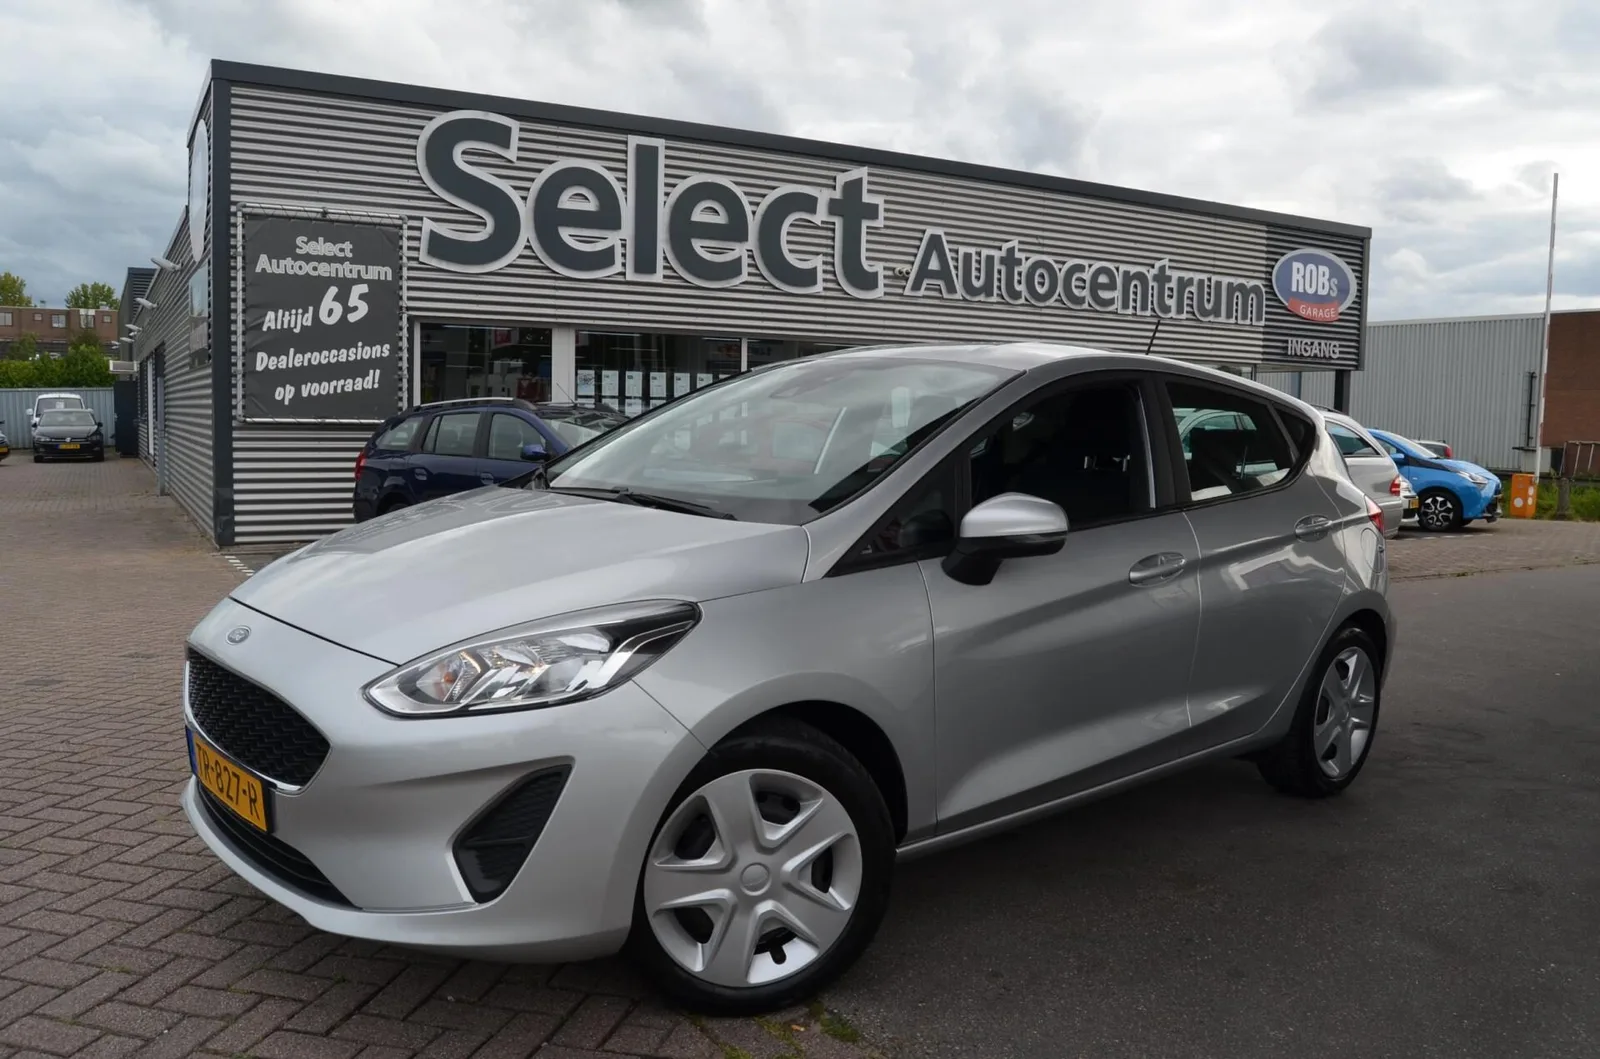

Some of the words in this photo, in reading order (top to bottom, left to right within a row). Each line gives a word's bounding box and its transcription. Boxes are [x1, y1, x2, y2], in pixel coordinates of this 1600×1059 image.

[417, 110, 884, 299] Select
[904, 228, 1265, 326] Autocentrum
[295, 236, 353, 258] Select
[255, 253, 393, 281] Autocentrum
[1291, 261, 1339, 297] ROBs
[262, 306, 314, 334] Altijd
[318, 283, 370, 326] 65
[1299, 304, 1336, 319] GARAGE
[255, 341, 391, 372] Dealeroccasions
[1287, 338, 1341, 360] INGANG
[274, 384, 295, 406] op
[301, 368, 381, 398] voorraad!
